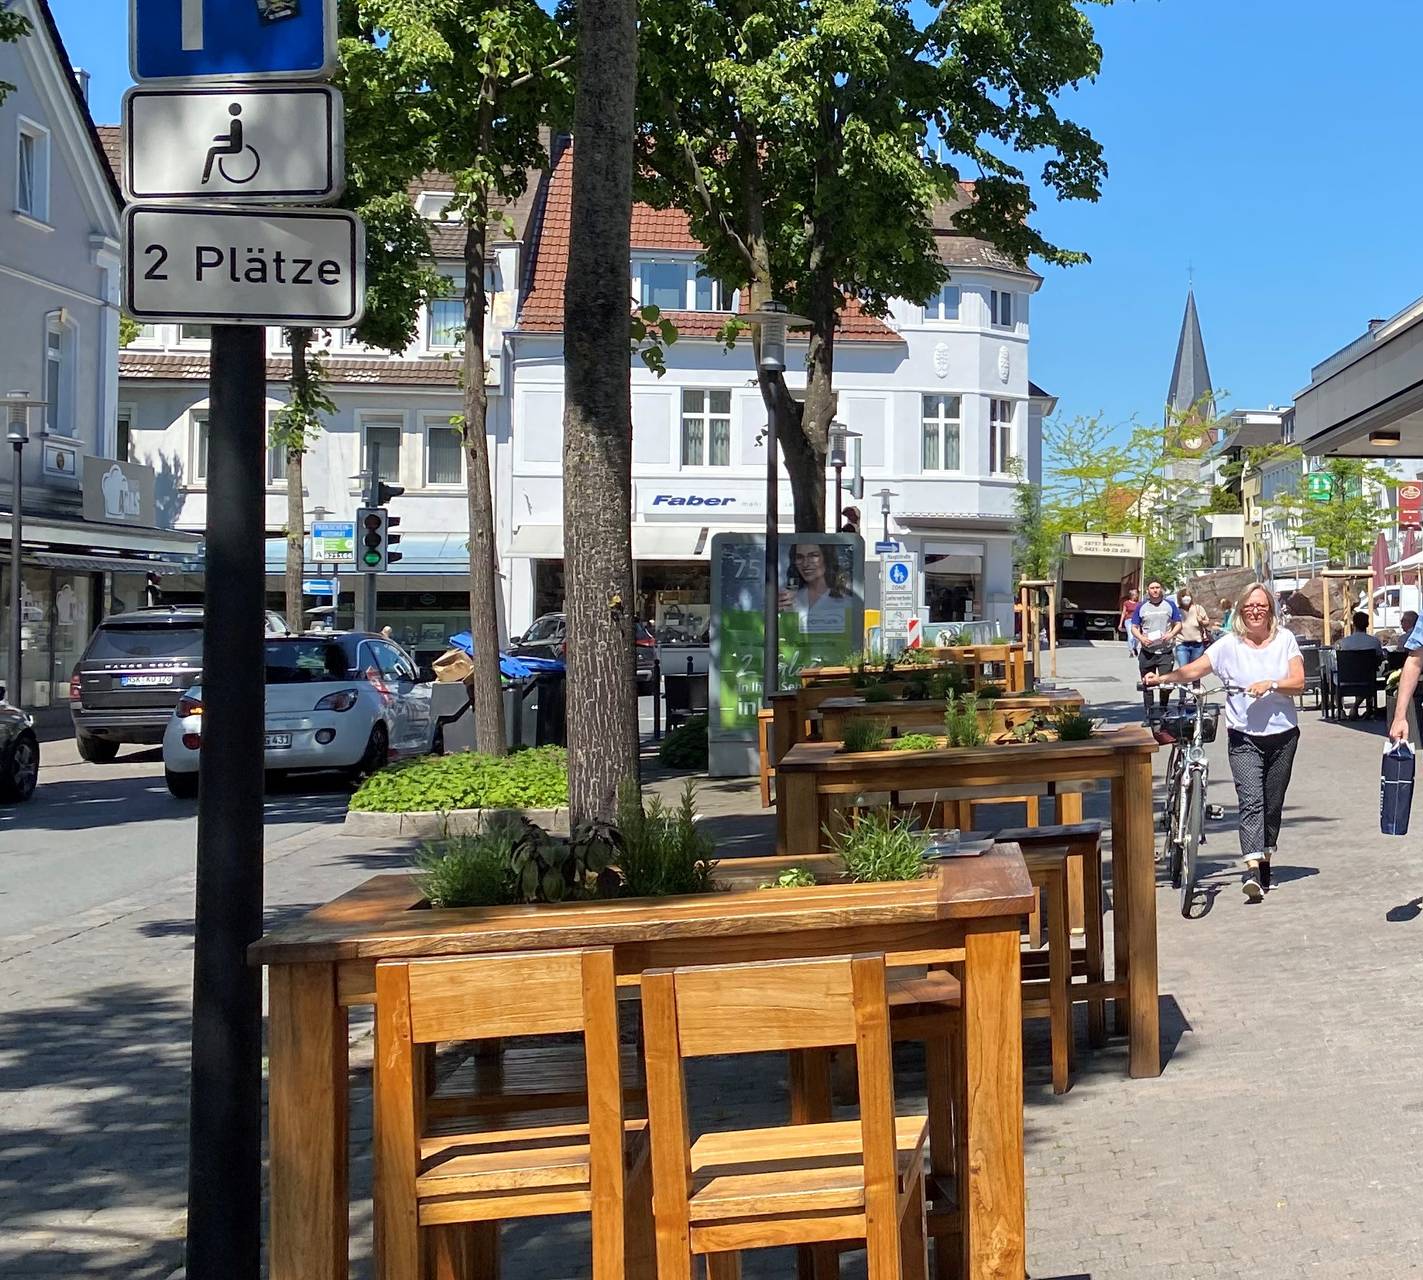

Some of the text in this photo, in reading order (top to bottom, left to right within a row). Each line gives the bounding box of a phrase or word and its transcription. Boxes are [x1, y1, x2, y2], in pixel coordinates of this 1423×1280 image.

[144, 244, 341, 286] 2 Plätze
[652, 495, 737, 506] Faber
[272, 735, 289, 745] 431
